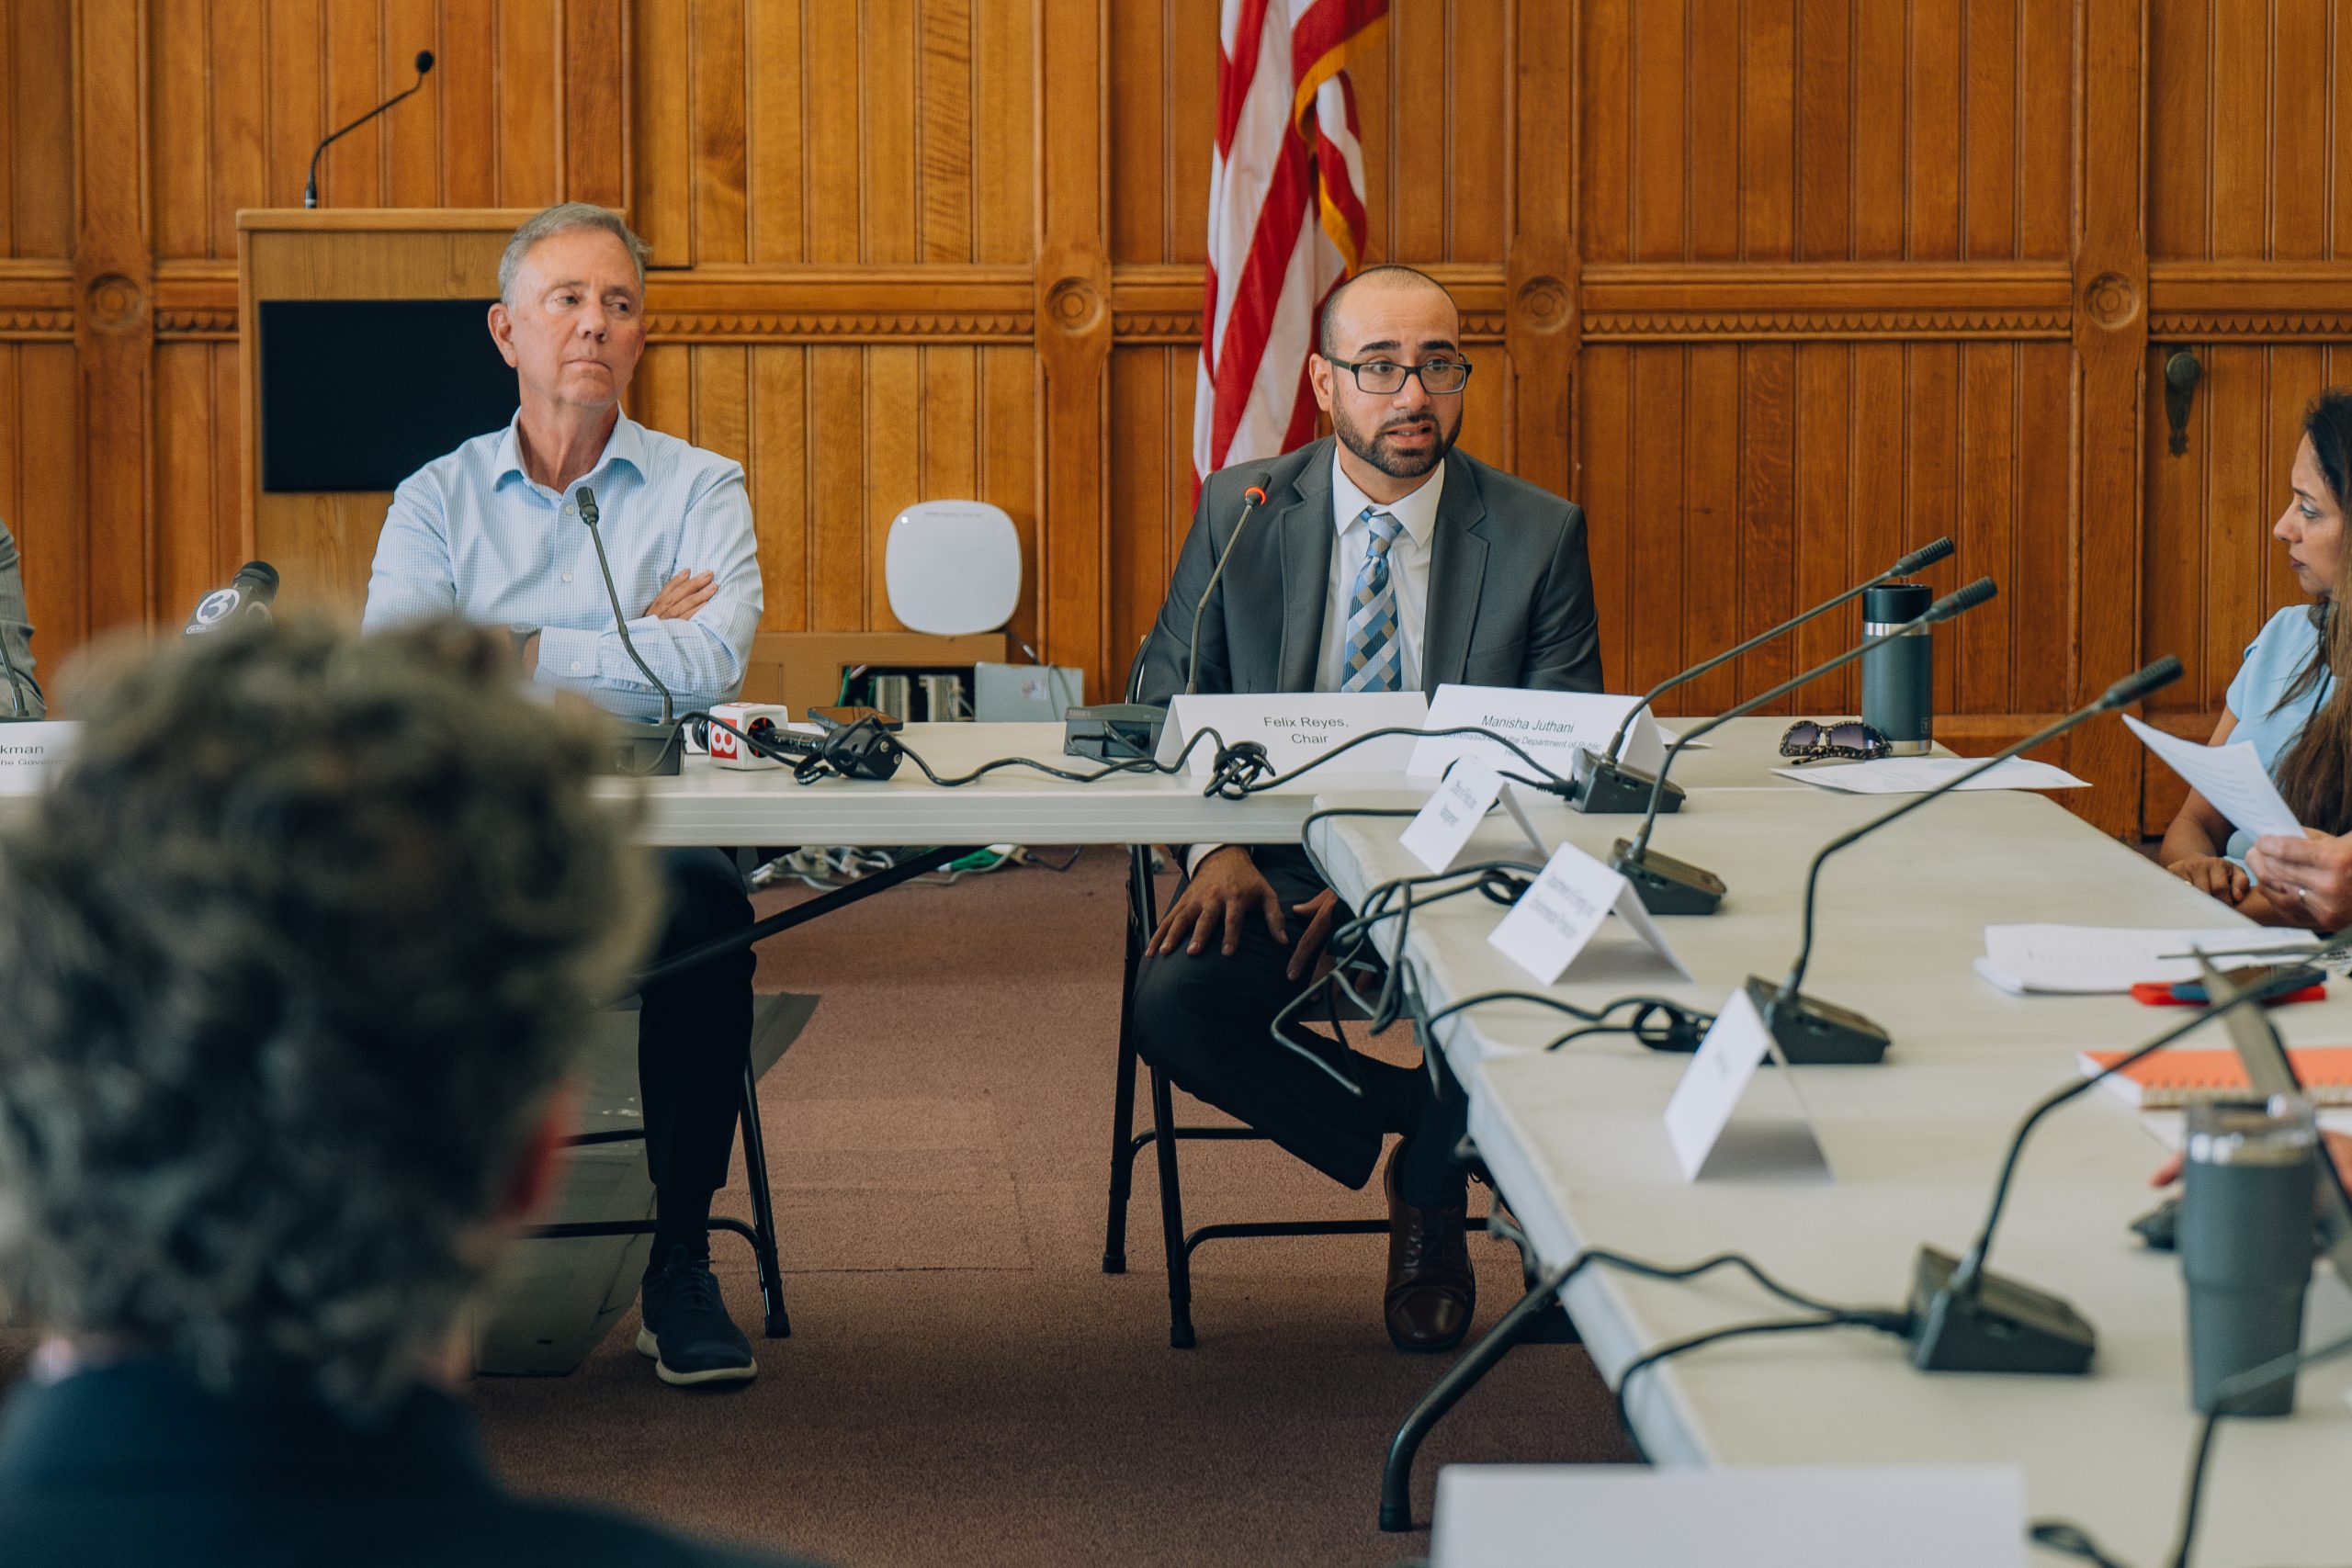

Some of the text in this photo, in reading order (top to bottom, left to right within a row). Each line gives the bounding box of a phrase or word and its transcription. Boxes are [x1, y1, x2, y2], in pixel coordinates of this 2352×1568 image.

[1263, 716, 1349, 729] Felix Reyes,
[1481, 715, 1576, 734] Manisha Juthani
[711, 723, 736, 754] 8
[1291, 733, 1329, 744] Chair
[1521, 737, 1567, 748] Department
